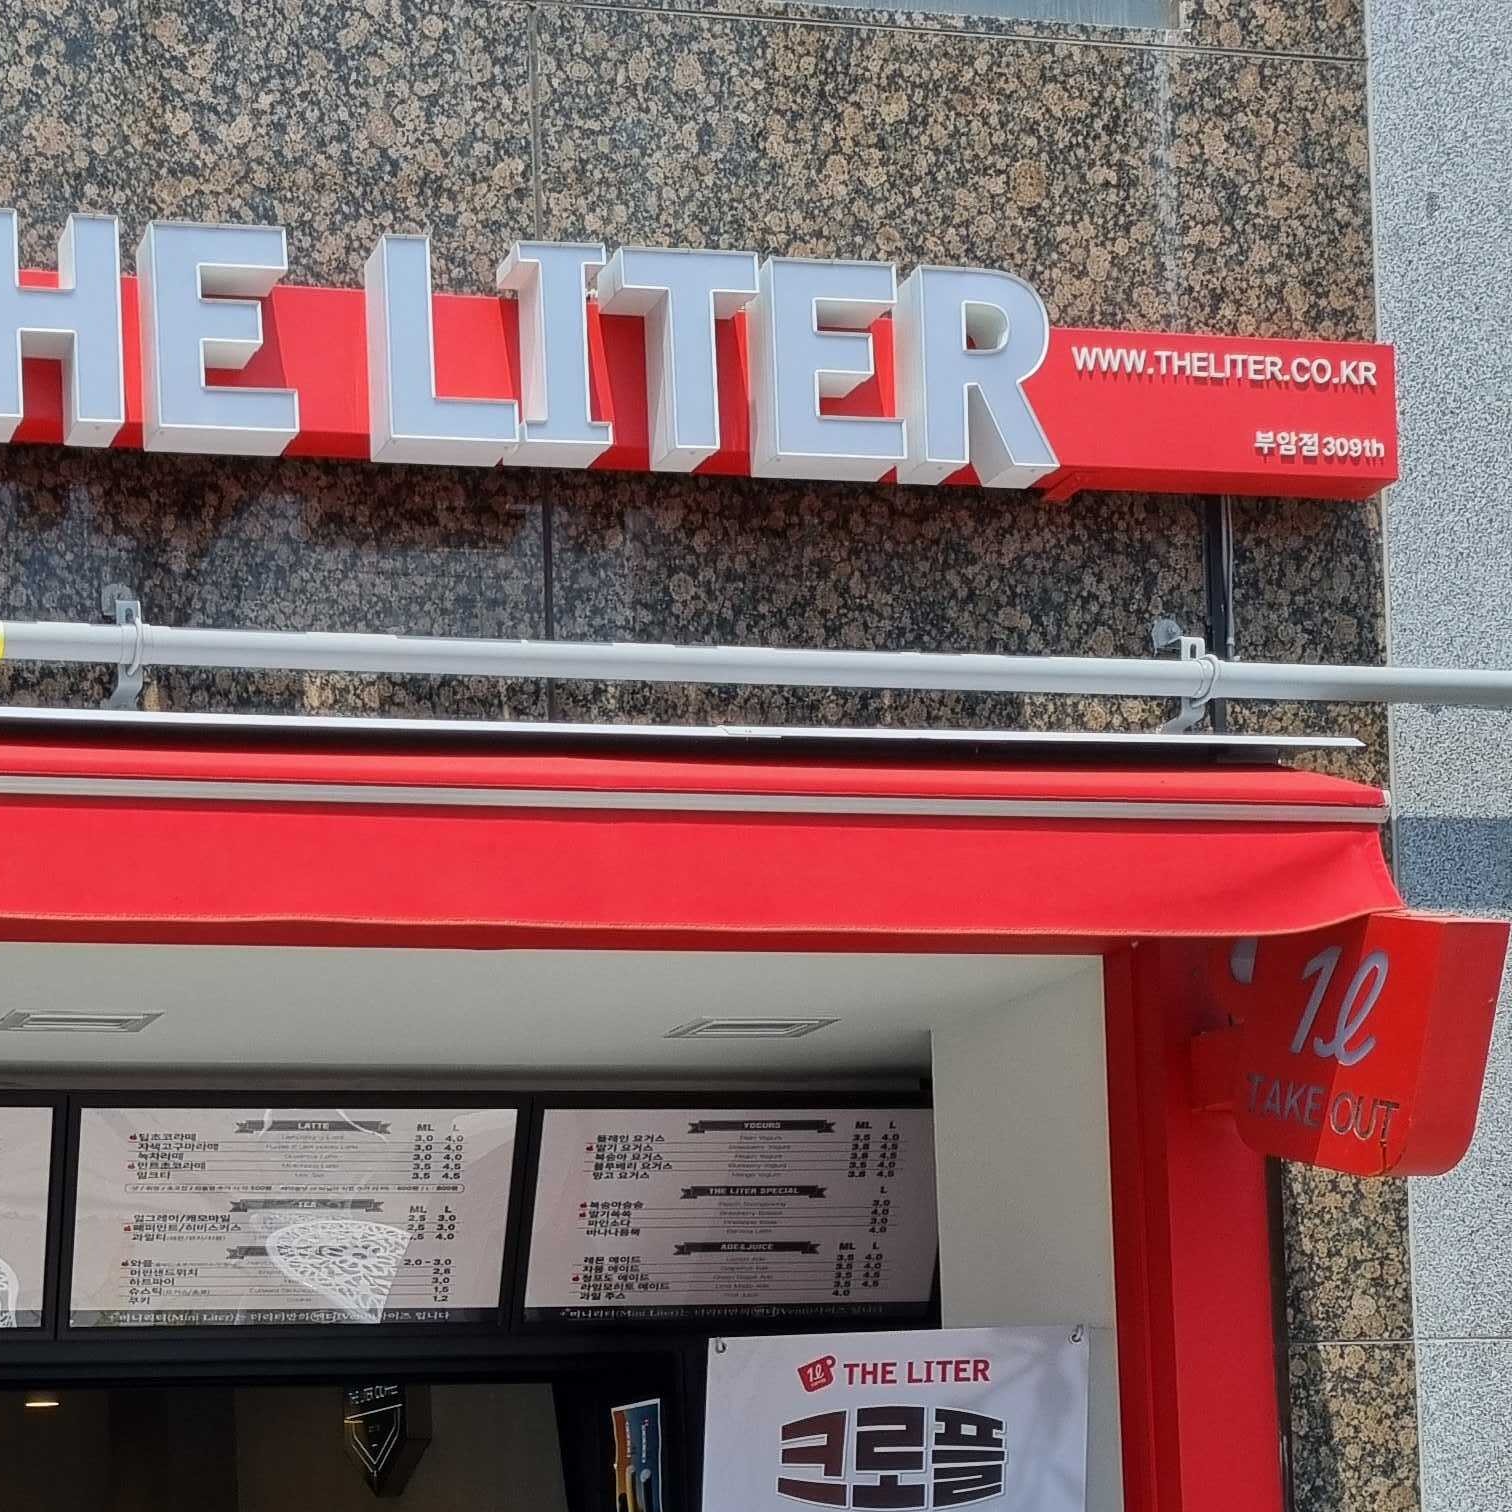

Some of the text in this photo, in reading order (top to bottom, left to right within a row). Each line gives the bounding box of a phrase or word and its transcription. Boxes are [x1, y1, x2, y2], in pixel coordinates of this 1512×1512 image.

[364, 234, 1061, 488] LITER
[1071, 346, 1378, 387] WWW.THELITER.CO.KR
[1254, 430, 1385, 459] 부암점 309th
[298, 1122, 329, 1130] LATTE
[1247, 1071, 1400, 1140] TAKE OUT
[843, 1359, 992, 1386] THE LITER
[776, 1404, 1008, 1512] 크로플
